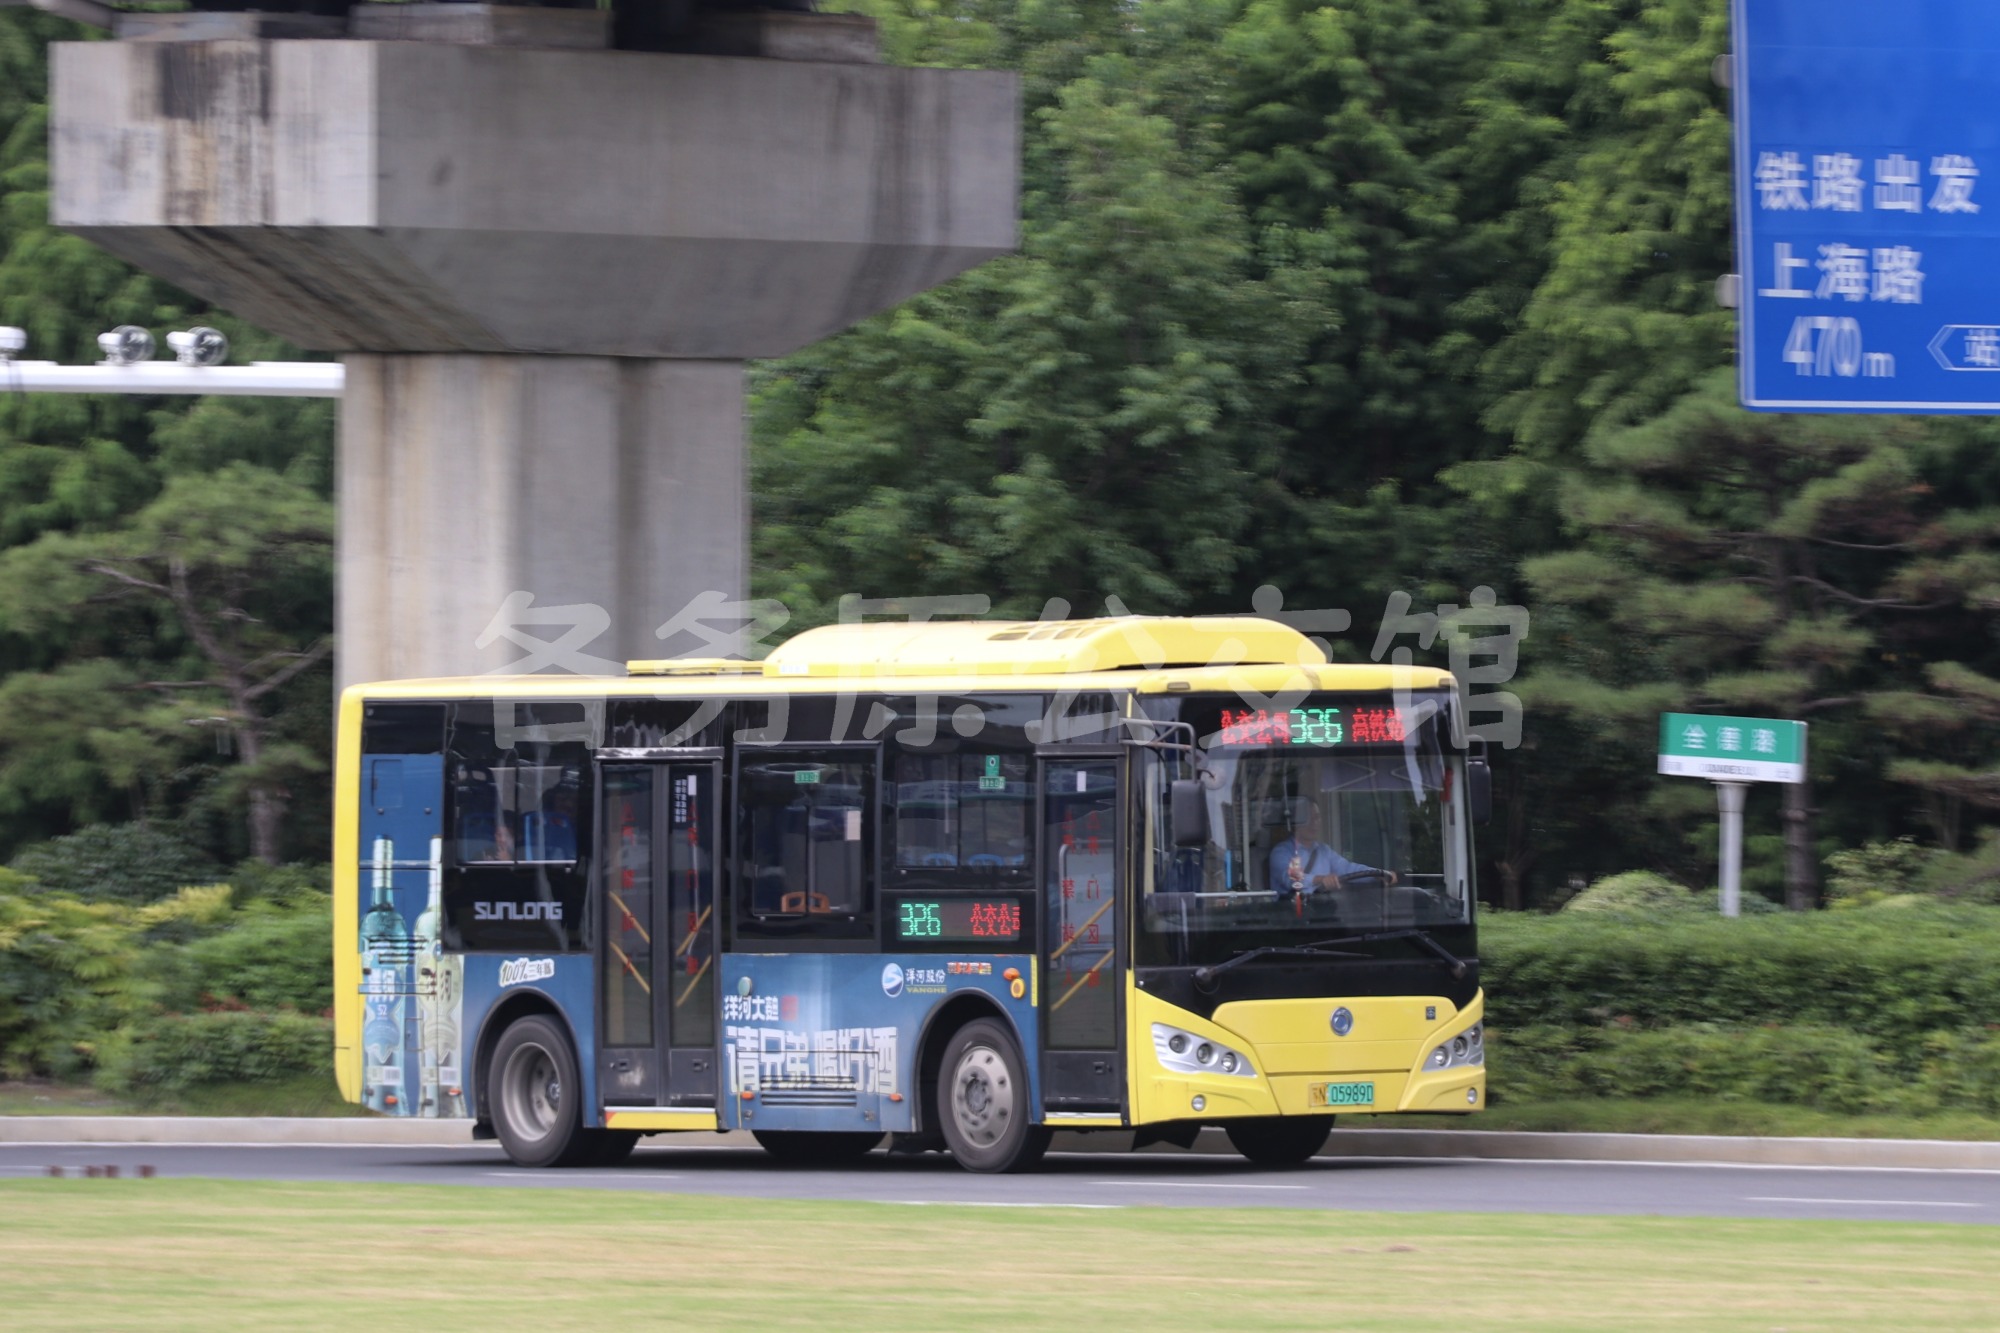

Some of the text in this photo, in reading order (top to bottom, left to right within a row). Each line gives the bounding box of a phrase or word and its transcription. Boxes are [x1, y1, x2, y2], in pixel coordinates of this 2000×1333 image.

[1754, 152, 1981, 214] 铁路出发
[1758, 243, 1926, 304] 上海路
[1782, 315, 1896, 378] 470m
[1290, 708, 1343, 743] 326
[474, 901, 563, 920] SUNLONG
[901, 903, 940, 935] 326
[905, 968, 947, 985] 洋河股份
[906, 986, 947, 994] YANGHE
[1331, 1085, 1374, 1103] 05989D
